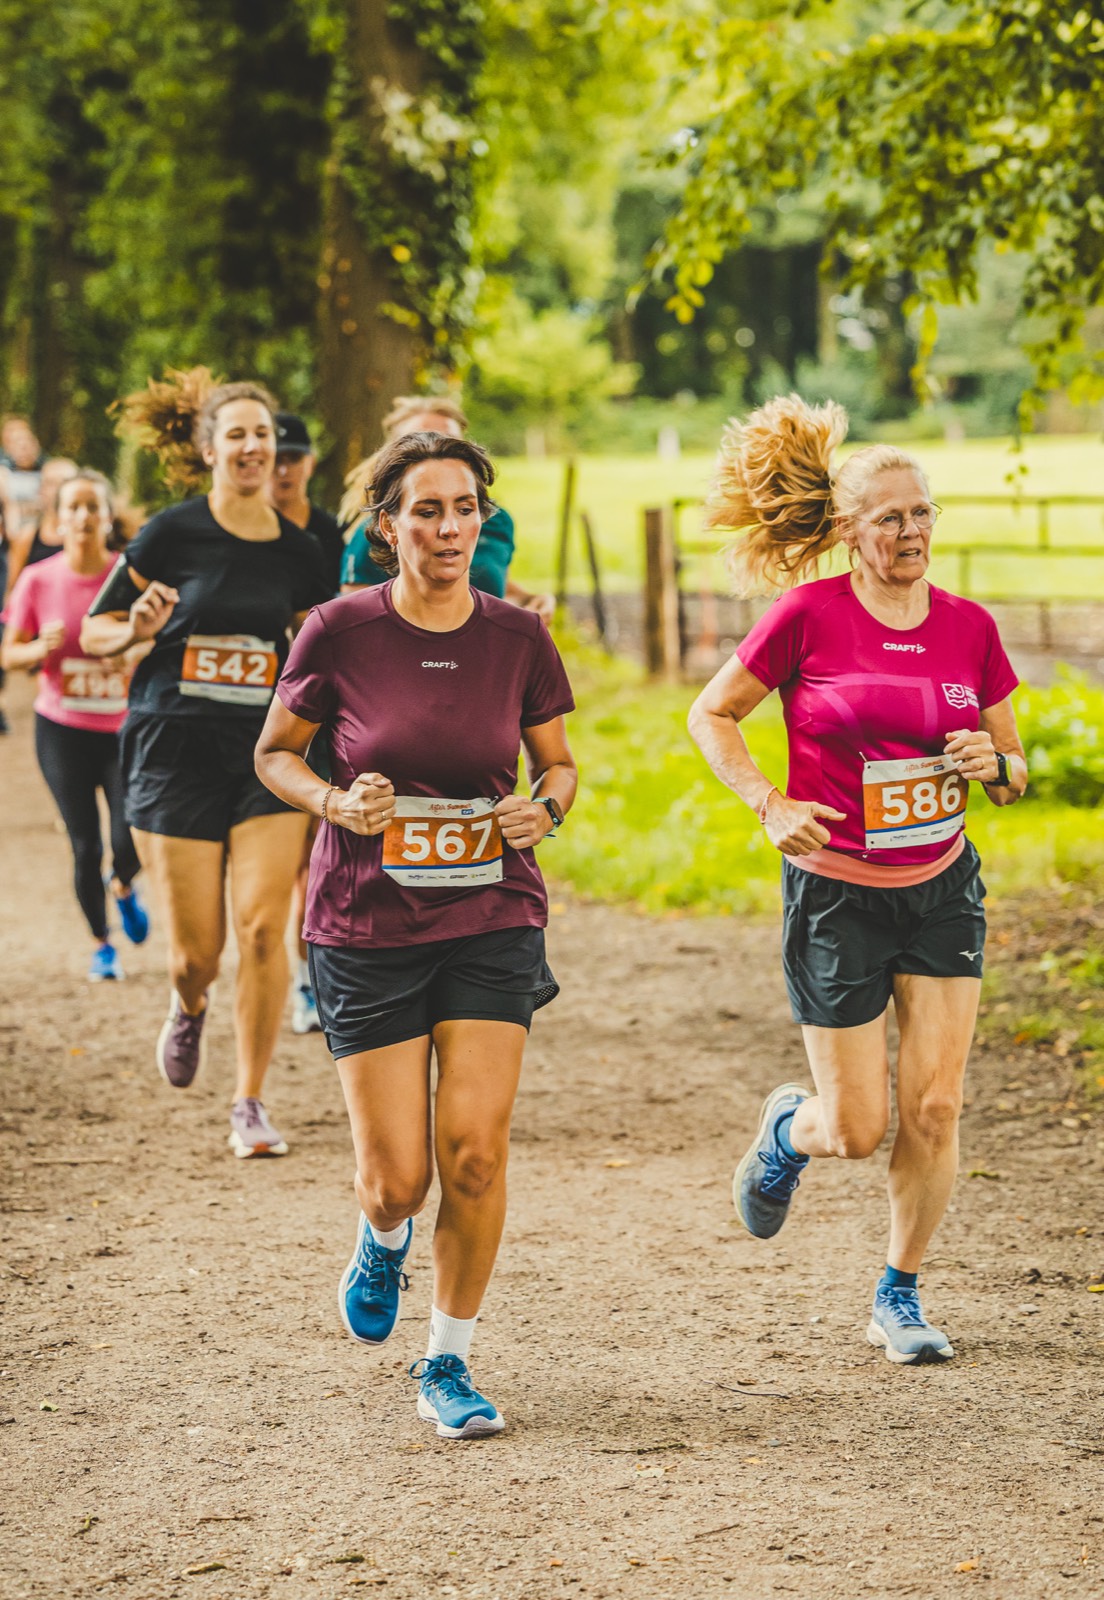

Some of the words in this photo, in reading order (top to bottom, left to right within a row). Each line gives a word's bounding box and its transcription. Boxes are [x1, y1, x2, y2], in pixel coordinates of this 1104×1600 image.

[195, 649, 268, 685] 542
[883, 642, 916, 652] CRAFT
[882, 774, 961, 824] 586
[401, 818, 493, 862] 567
